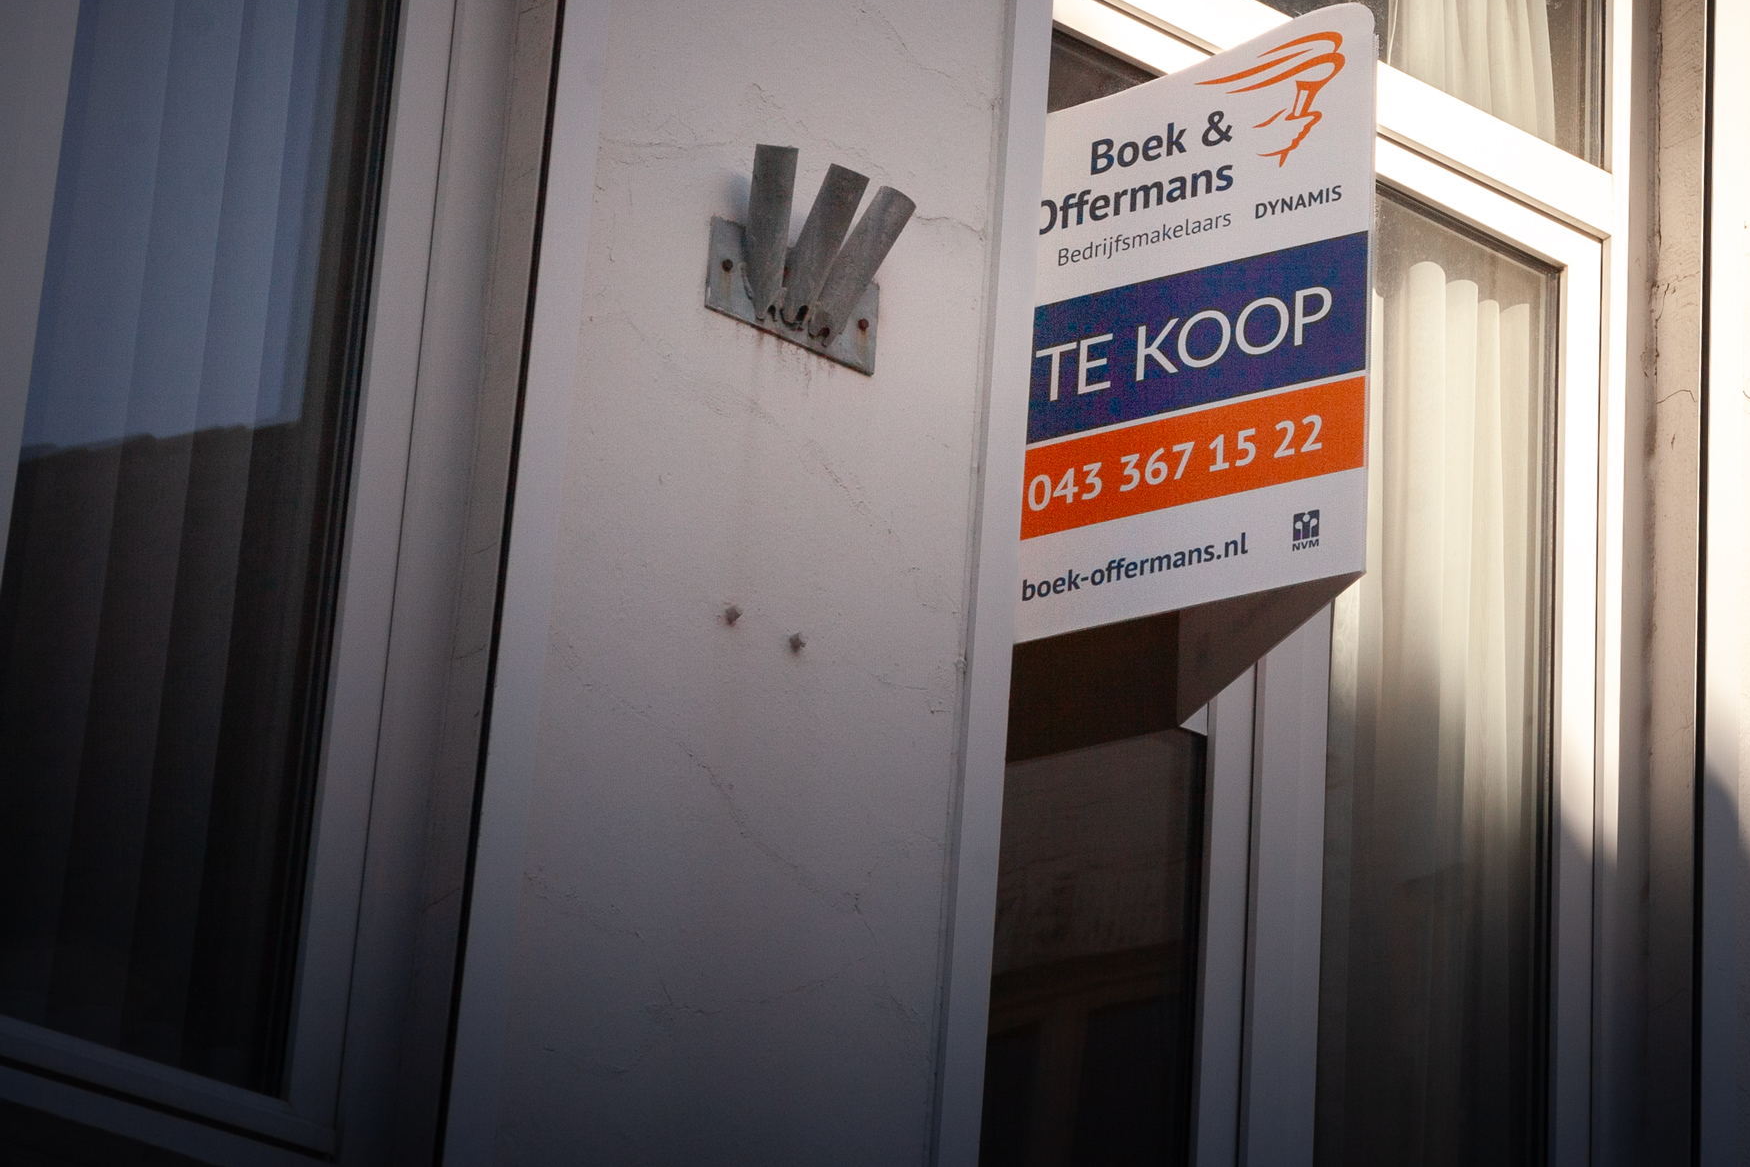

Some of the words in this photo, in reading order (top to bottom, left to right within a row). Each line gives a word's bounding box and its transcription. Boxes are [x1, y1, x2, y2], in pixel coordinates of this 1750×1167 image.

[1090, 122, 1187, 175] Boek
[1201, 110, 1233, 147] &
[1254, 185, 1342, 219] DYNAMIS
[1058, 212, 1231, 266] Bedrijfsmakelaars
[1035, 333, 1113, 402] TE
[1135, 286, 1333, 382] KOOP
[1027, 461, 1103, 512] 043
[1119, 441, 1195, 492] 367
[1209, 427, 1257, 472] 15
[1273, 414, 1323, 458] 22
[1021, 532, 1249, 602] boek-offermans.nl
[1292, 539, 1320, 552] NVM
